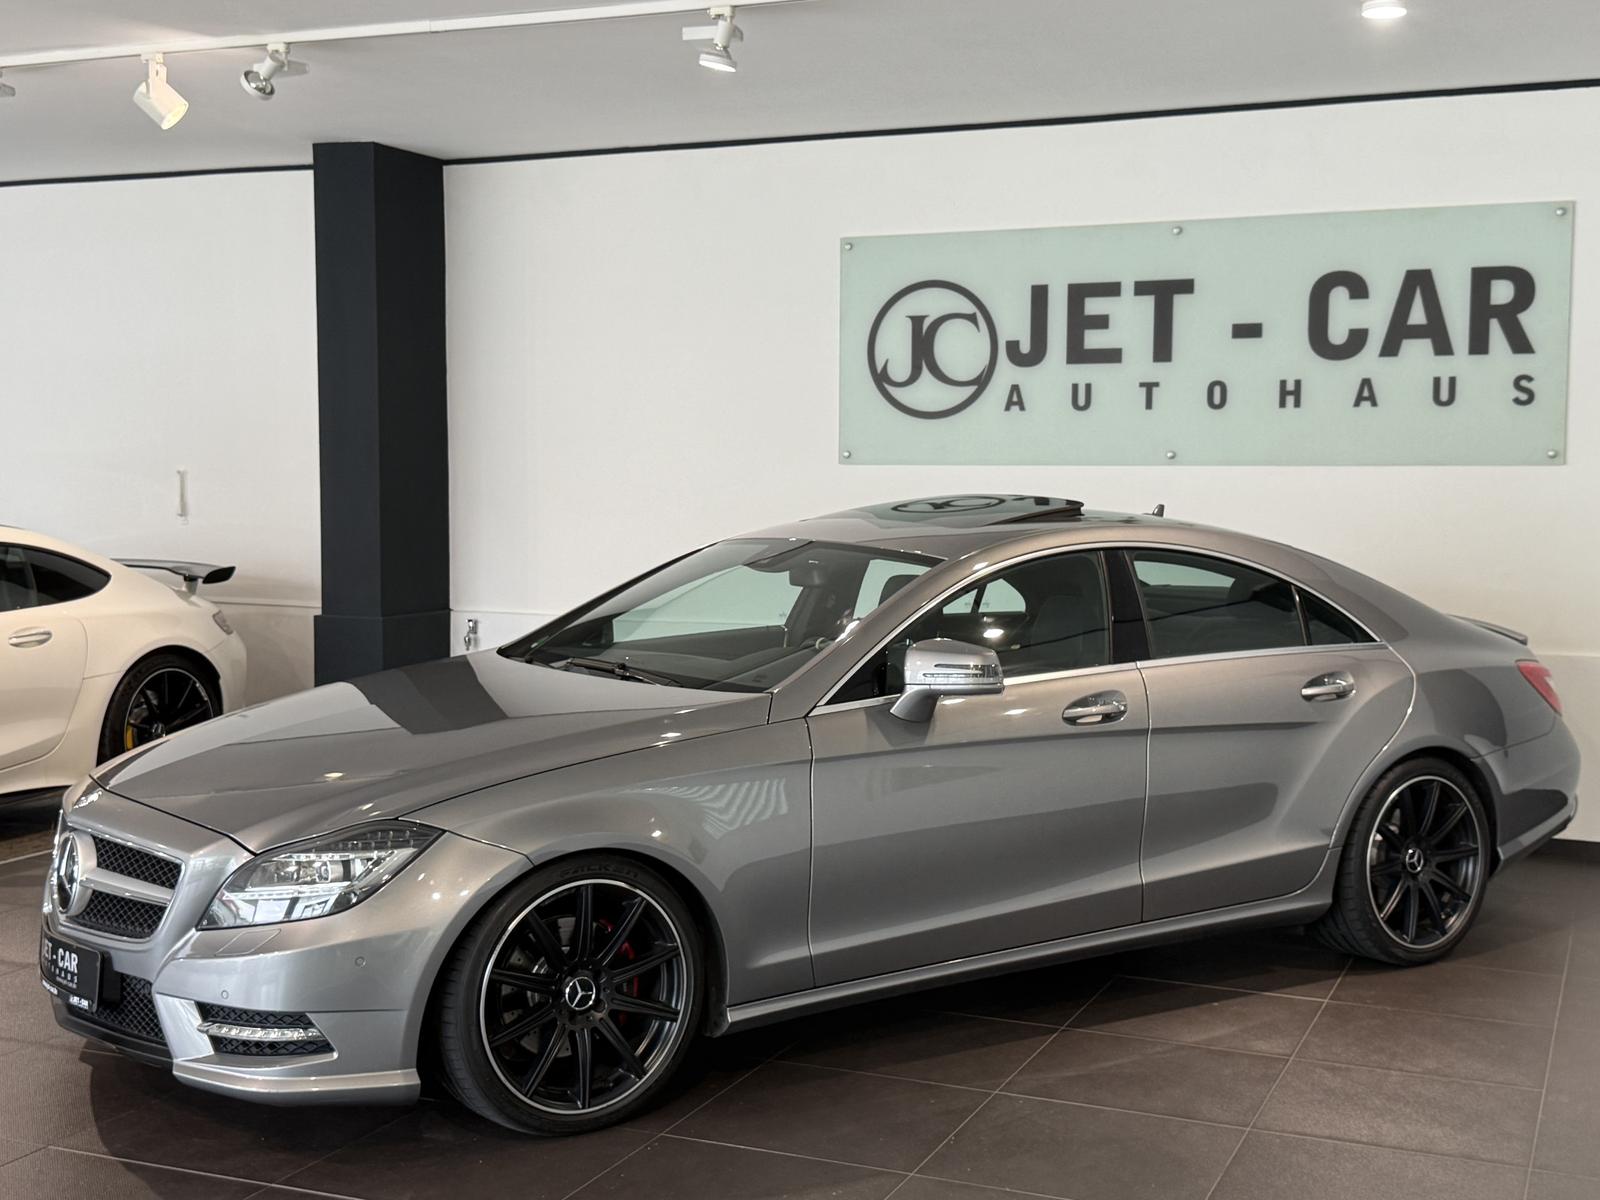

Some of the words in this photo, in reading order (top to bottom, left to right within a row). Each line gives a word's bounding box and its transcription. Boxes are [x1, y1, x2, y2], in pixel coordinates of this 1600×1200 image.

[1005, 278, 1195, 368] JET
[1307, 265, 1536, 361] CAR
[878, 311, 988, 388] JC
[1004, 374, 1536, 412] AUTOHAUS
[58, 947, 79, 974] CAR
